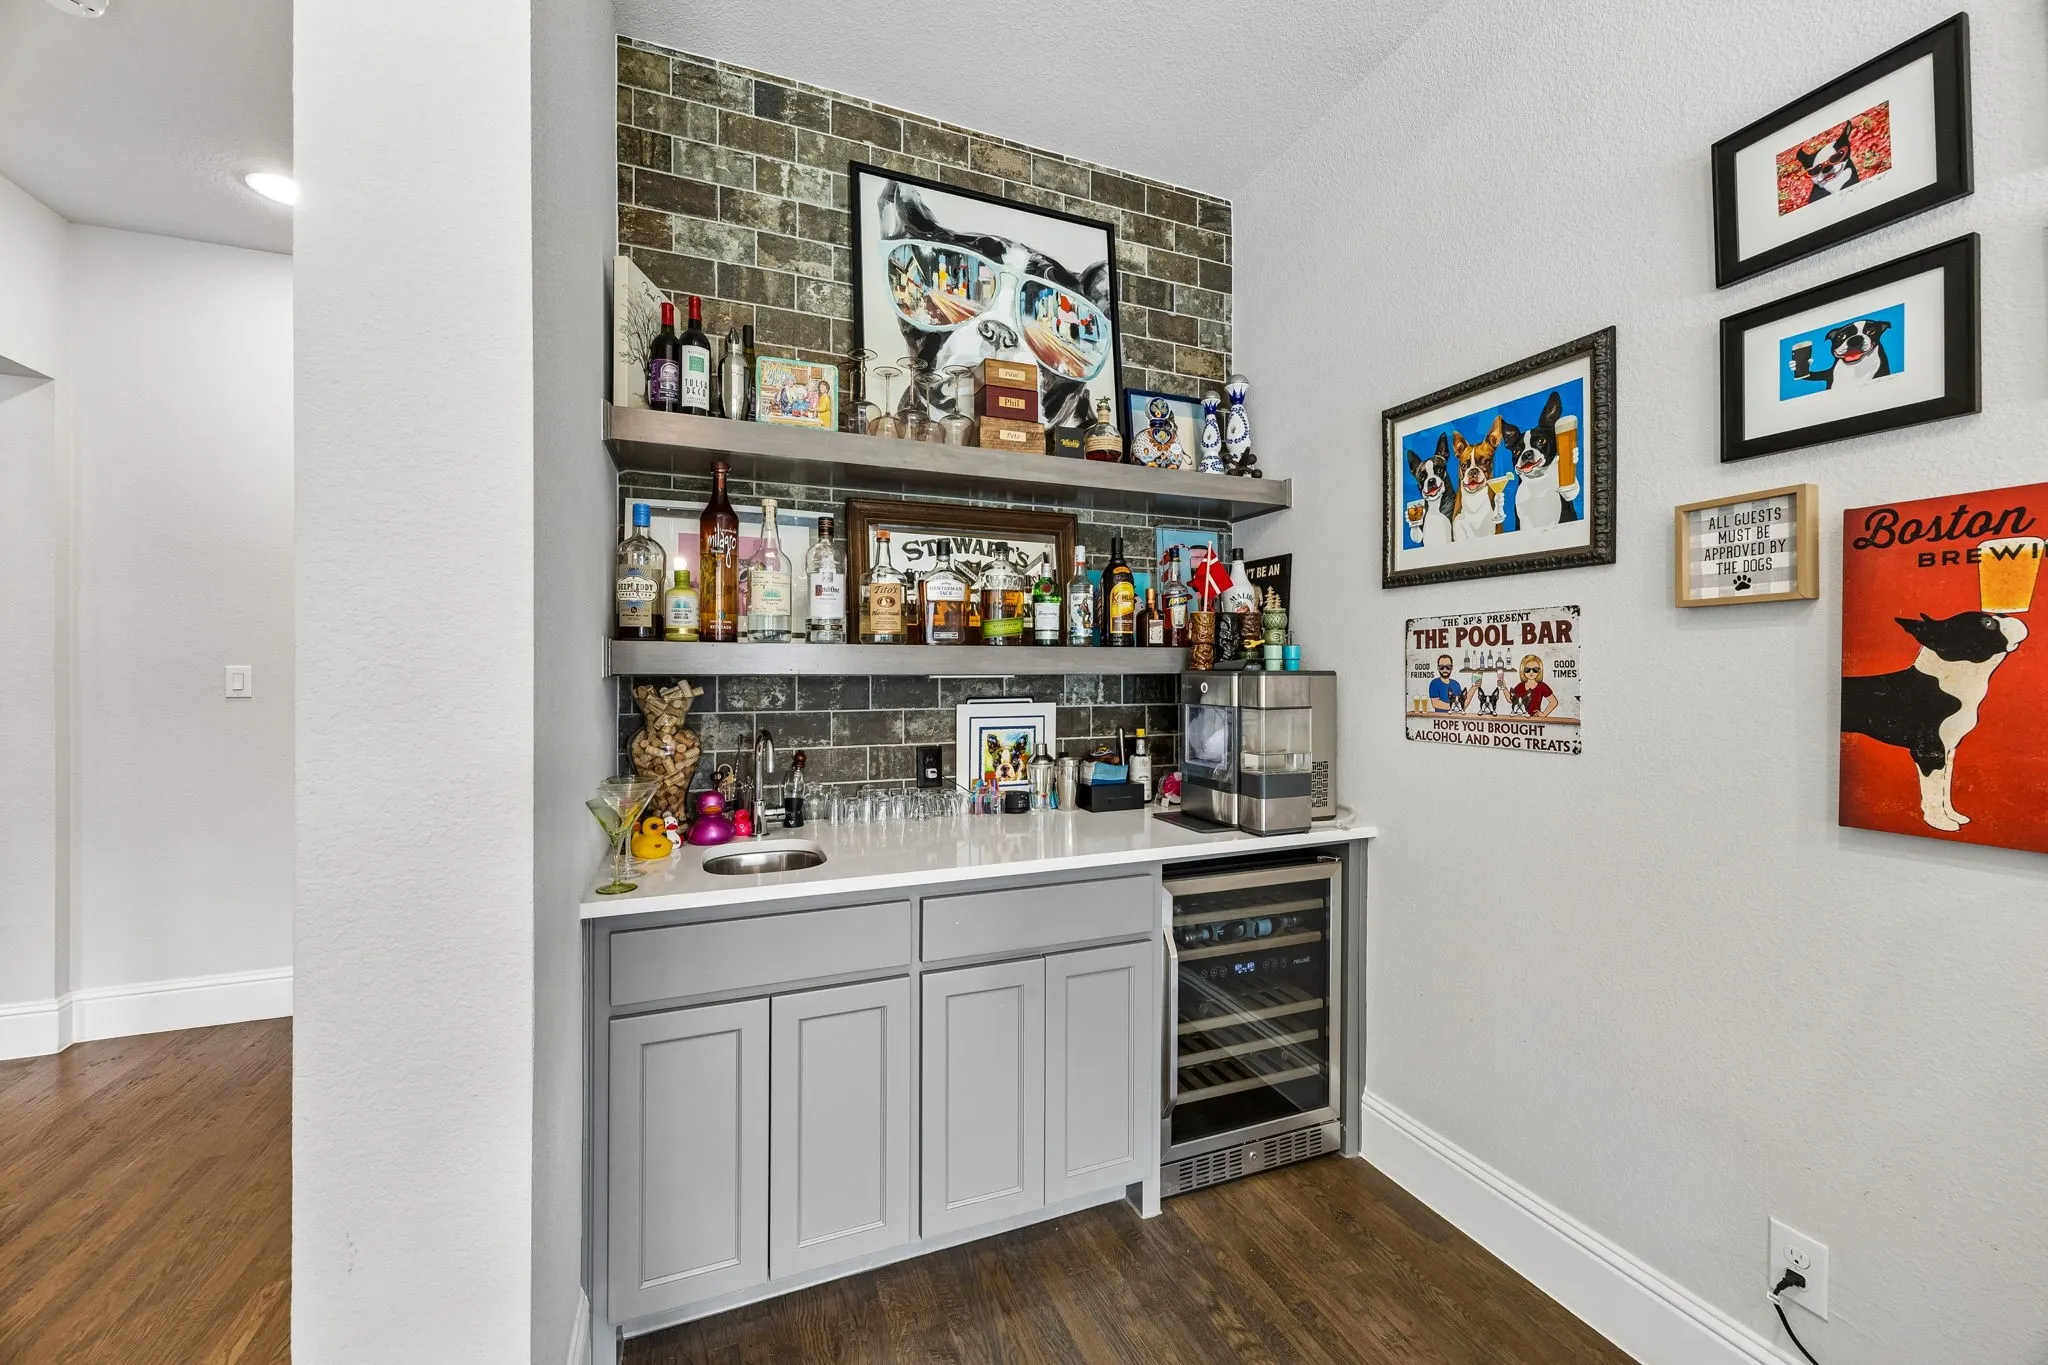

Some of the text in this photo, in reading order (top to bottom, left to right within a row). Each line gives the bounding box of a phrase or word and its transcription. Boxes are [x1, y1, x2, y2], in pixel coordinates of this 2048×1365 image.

[685, 378, 708, 390] TULSA
[686, 386, 706, 398] DECO
[1004, 398, 1020, 407] Phil
[1006, 432, 1021, 440] Pete
[1708, 507, 1781, 530] ALL GUESTS
[1718, 525, 1770, 544] MUST BE
[1853, 504, 2036, 550] Boston
[708, 525, 736, 568] milagro
[1704, 539, 1786, 561] APPROVED BY
[1918, 543, 2048, 568] BREWI
[1256, 565, 1267, 579] BE
[1268, 563, 1280, 577] AN
[1716, 557, 1772, 575] THE DOGS
[618, 583, 654, 591] DEEP EDDY
[874, 585, 898, 594] Tito's
[871, 608, 901, 616] Handmade
[1442, 612, 1531, 627] THE 3P'S PRESENT
[1413, 620, 1573, 649] THE POOL BAR
[1414, 663, 1430, 671] GOOD
[1554, 659, 1576, 668] GOOD
[1410, 671, 1435, 679] FRIENDS
[1552, 669, 1577, 678] TIMES
[1433, 719, 1545, 737] HOPE YOU BROUGHT
[1415, 730, 1571, 753] ALCOHOL AND DOG TREATS
